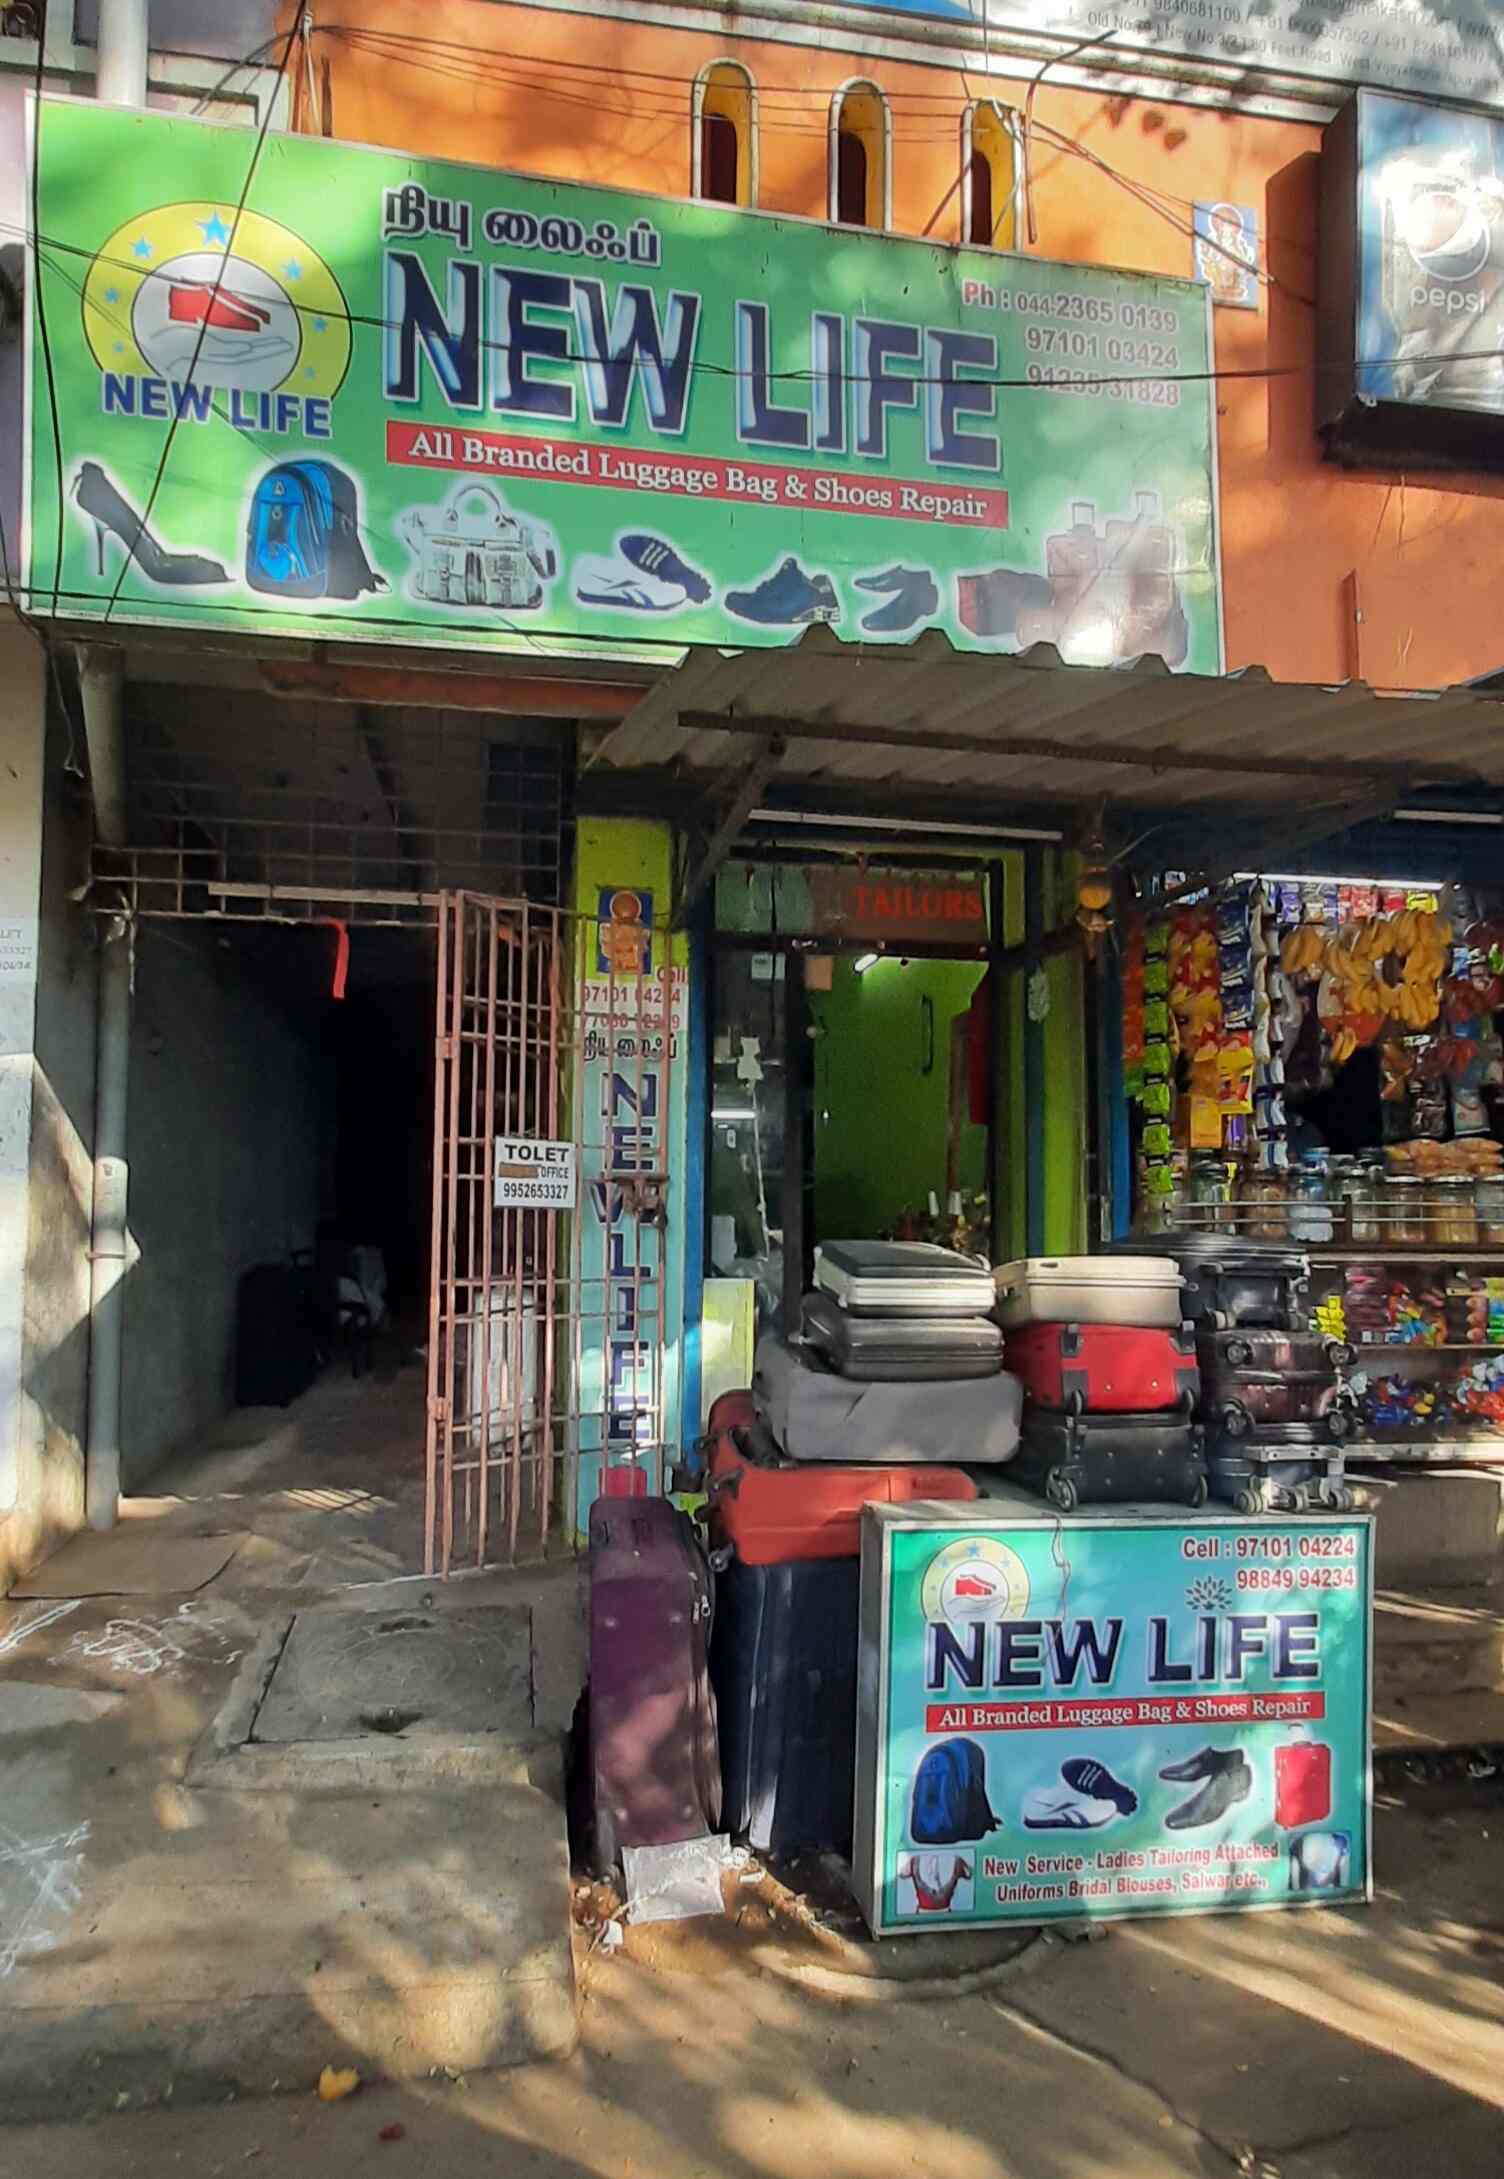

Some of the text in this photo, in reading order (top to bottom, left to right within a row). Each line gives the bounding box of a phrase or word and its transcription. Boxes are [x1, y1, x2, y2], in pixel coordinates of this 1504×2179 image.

[963, 279, 994, 306] Ph
[1121, 304, 1178, 333] 0139
[1409, 285, 1486, 314] pepsi
[383, 248, 1002, 472] NEW LIFE
[1027, 327, 1178, 369] 97101 03424
[103, 372, 333, 439] NEW LIFE
[408, 431, 987, 520] All Branded Luggage Bag & Shoes Repair
[635, 986, 681, 1004] 424
[540, 1165, 569, 1179] OFFICE
[503, 1182, 569, 1200] 9952653327
[1183, 1537, 1219, 1558] Cell
[1236, 1536, 1292, 1558] 97101
[1298, 1536, 1355, 1557] 04224
[1237, 1568, 1355, 1590] 98849 94234
[925, 1612, 1320, 1691] NEW LIFE
[939, 1696, 1311, 1727] All Branded Luggage Bag & Shoes Repair
[984, 1856, 1018, 1876] New
[1027, 1853, 1083, 1874] Service
[1096, 1851, 1145, 1870] Ladies
[1150, 1848, 1211, 1868] Tailoring
[1214, 1841, 1279, 1861] Attached
[997, 1881, 1064, 1902] Uniforms
[1068, 1878, 1112, 1896] Bridal
[1116, 1874, 1177, 1894] Blouses,
